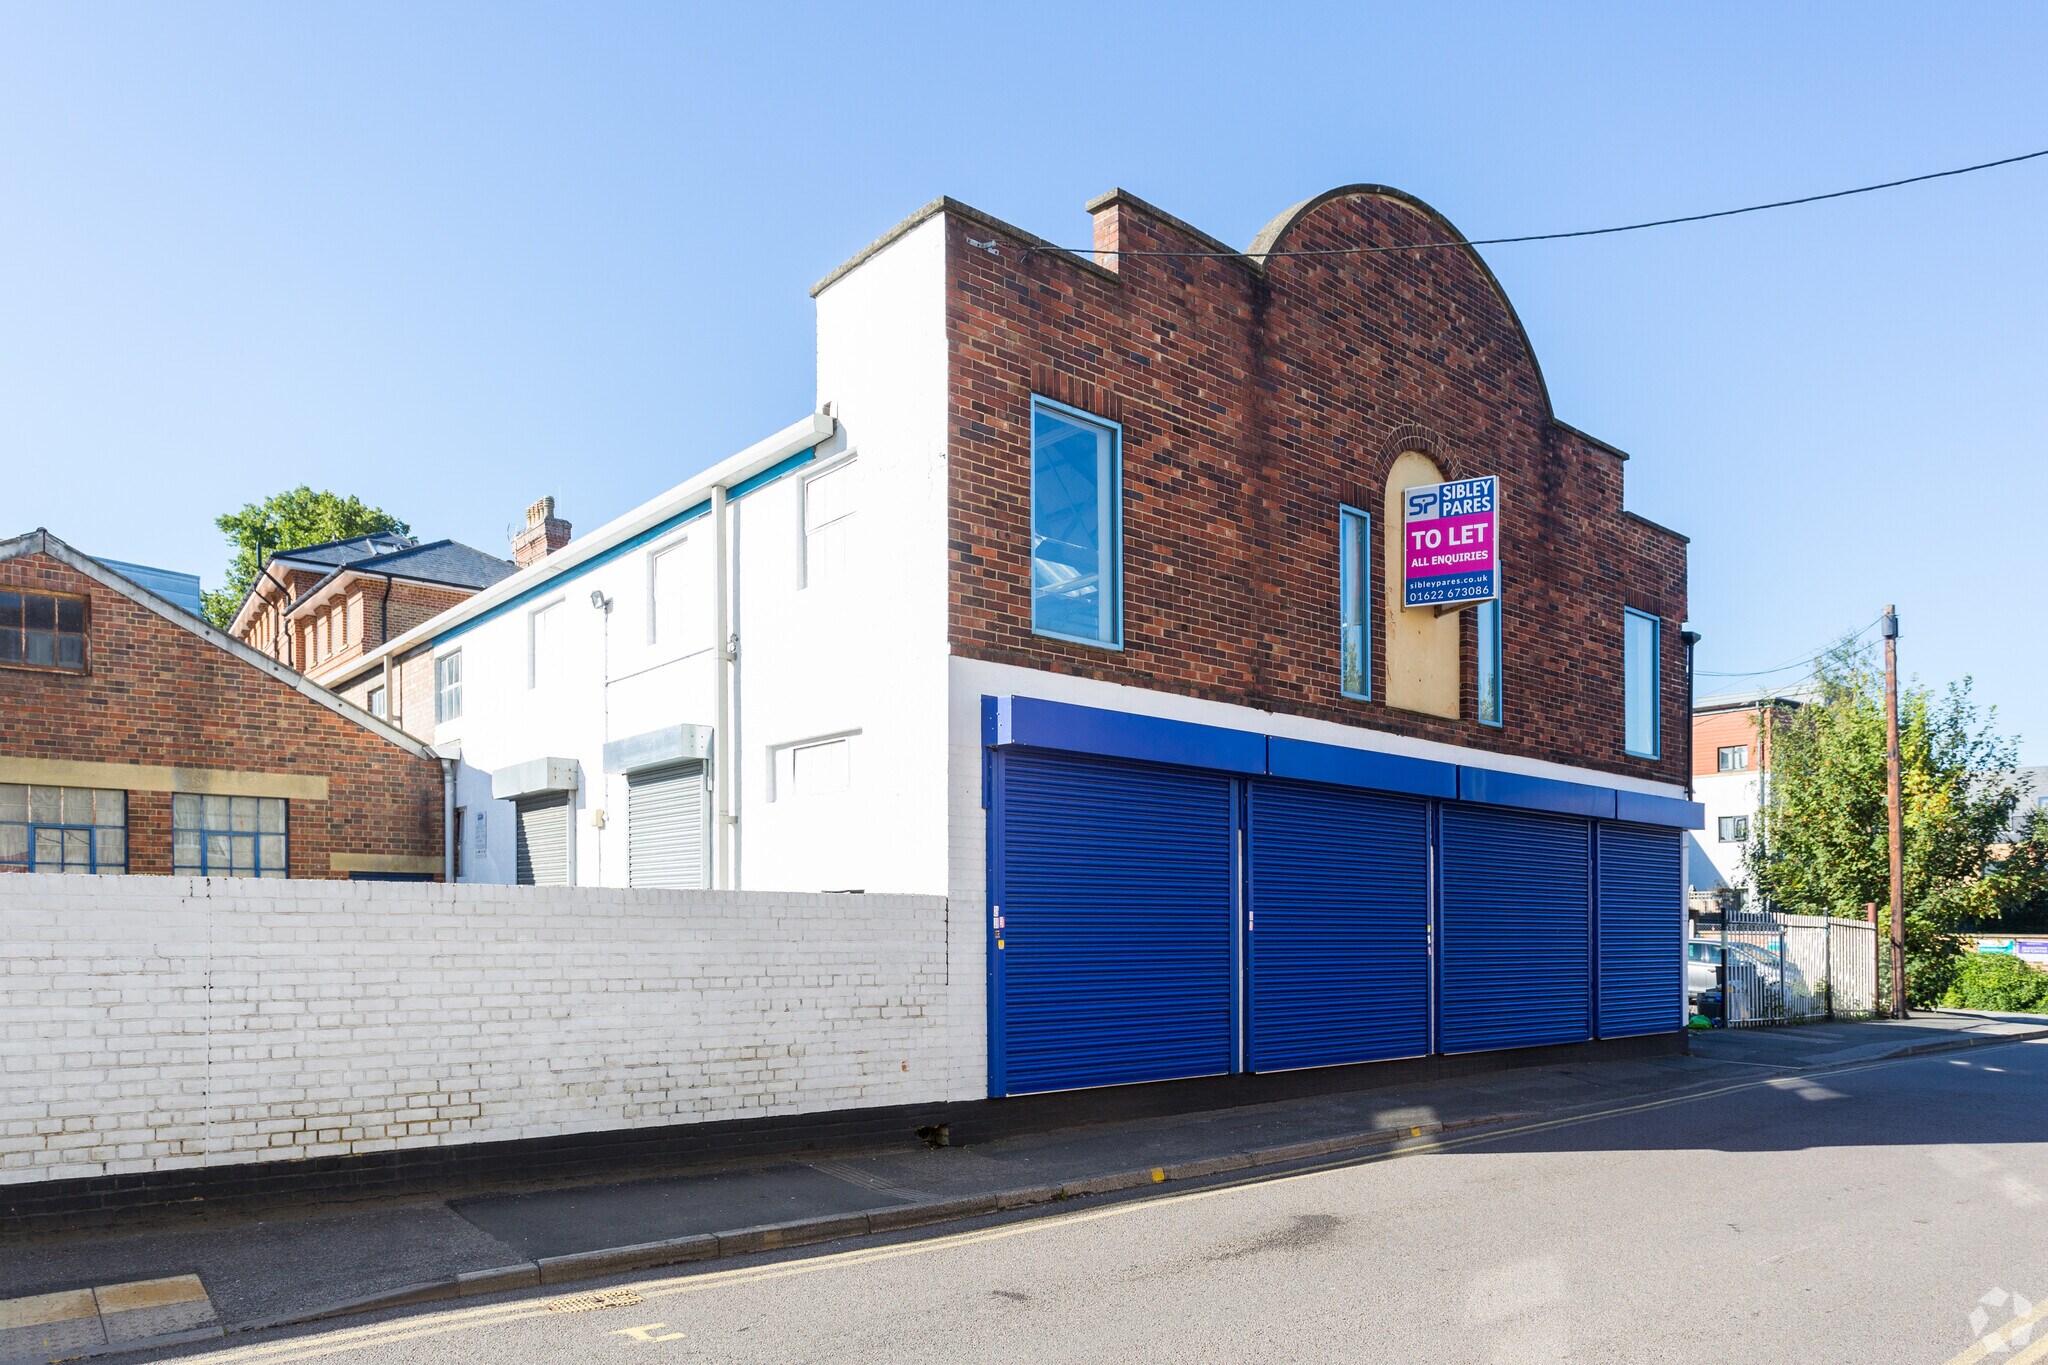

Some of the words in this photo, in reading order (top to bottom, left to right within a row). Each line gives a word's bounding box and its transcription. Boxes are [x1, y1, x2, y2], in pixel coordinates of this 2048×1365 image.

[1442, 480, 1491, 501] SIBLEY
[1443, 497, 1491, 516] PARES
[1411, 529, 1442, 550] TO
[1448, 523, 1488, 546] LET
[1411, 557, 1430, 568] ALL
[1431, 550, 1488, 565] ENQUIRIES
[1410, 575, 1488, 590] sibleypares.co.uk
[1410, 590, 1443, 602] 01622
[1447, 585, 1489, 598] 673086
